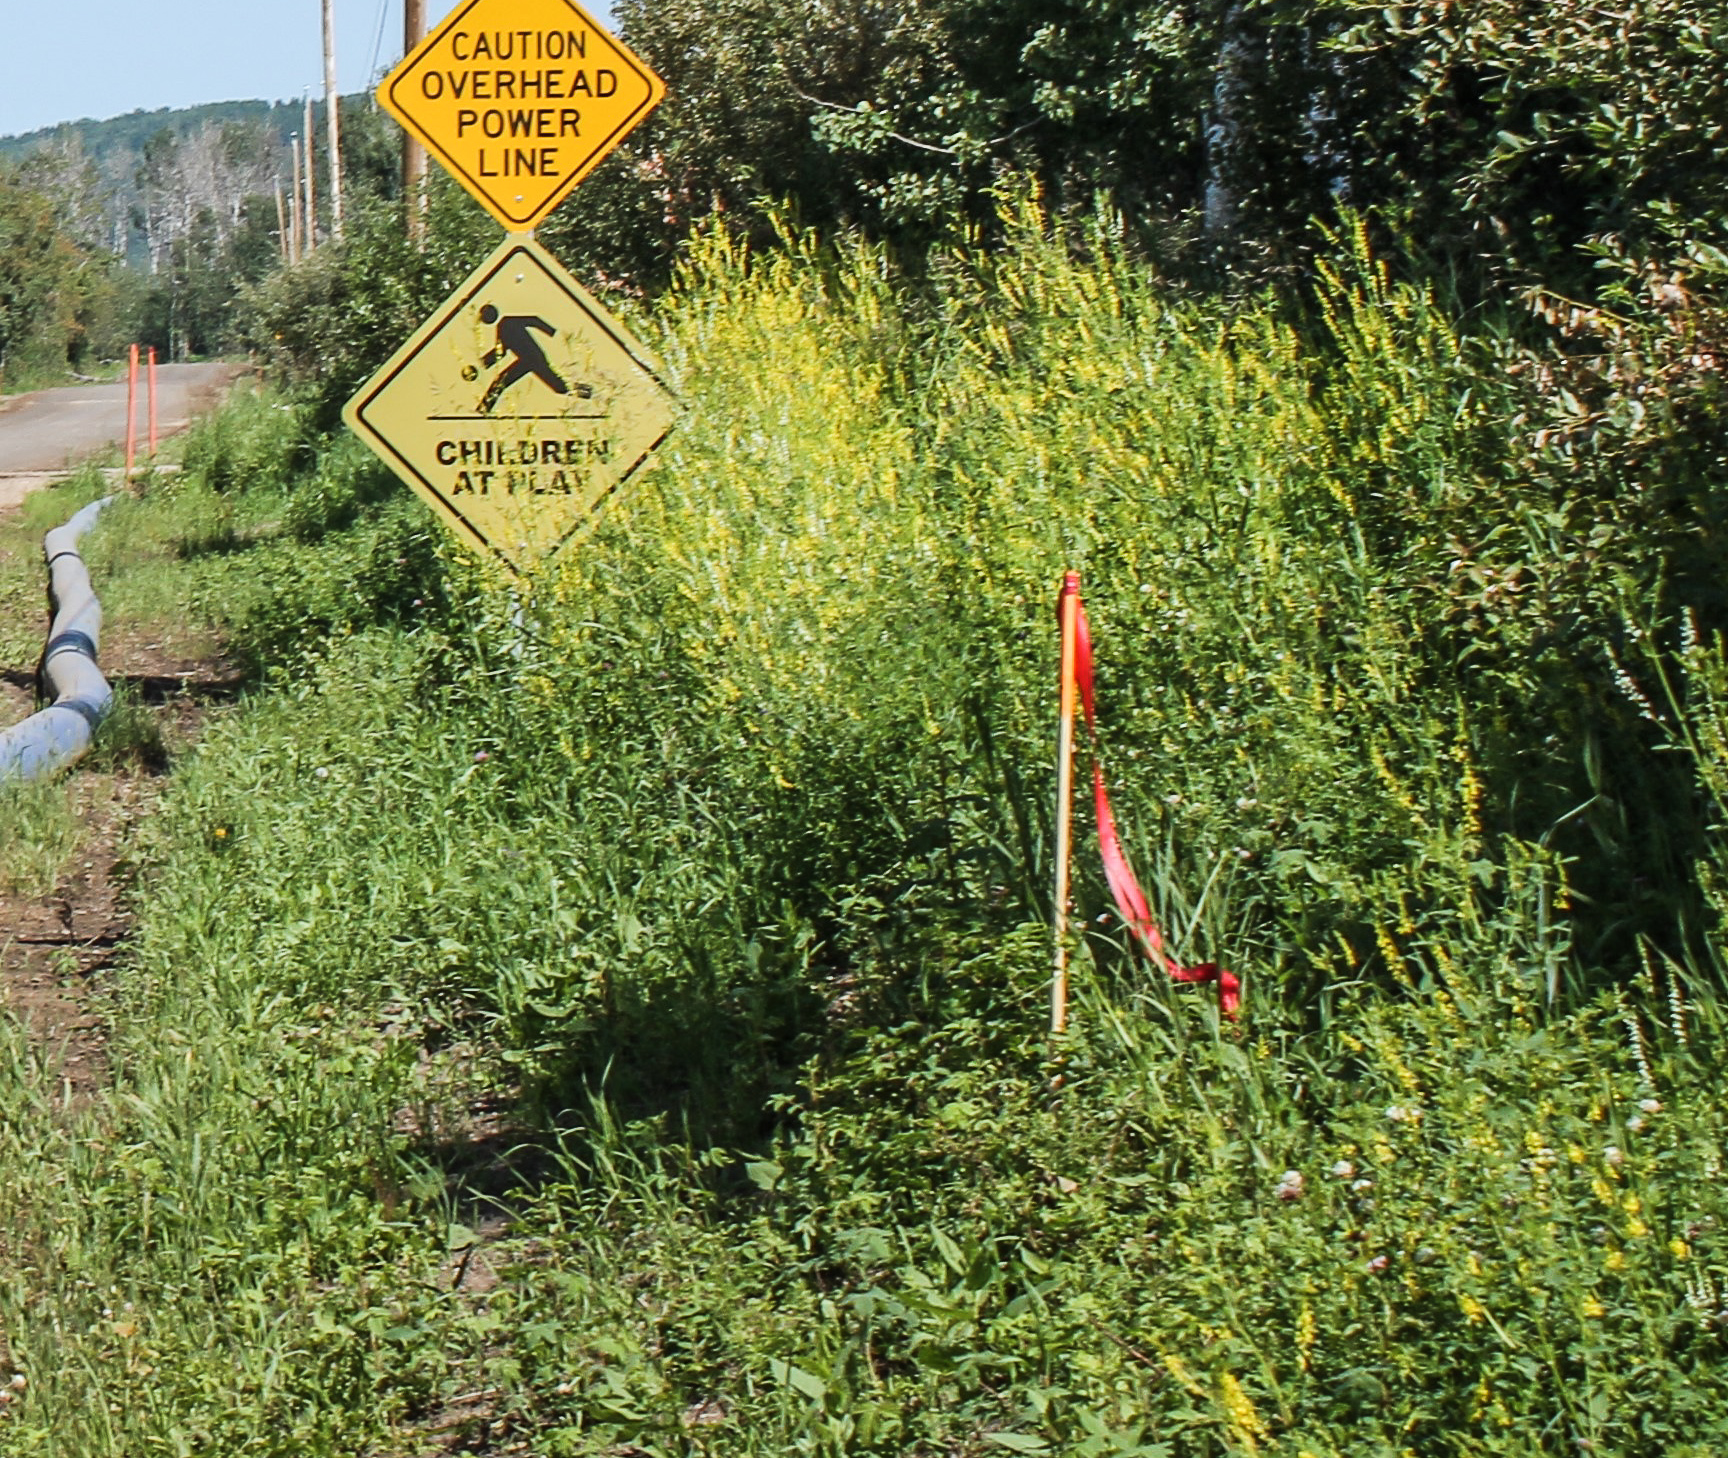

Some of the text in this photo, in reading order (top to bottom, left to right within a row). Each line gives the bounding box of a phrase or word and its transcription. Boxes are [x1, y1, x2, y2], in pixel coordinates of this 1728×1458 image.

[451, 30, 587, 62] CAUTION
[421, 69, 619, 101] OVERHEAD
[456, 109, 581, 139] POWER
[478, 148, 560, 178] LINE
[435, 439, 610, 466] CHILDREN
[451, 470, 495, 496] AT
